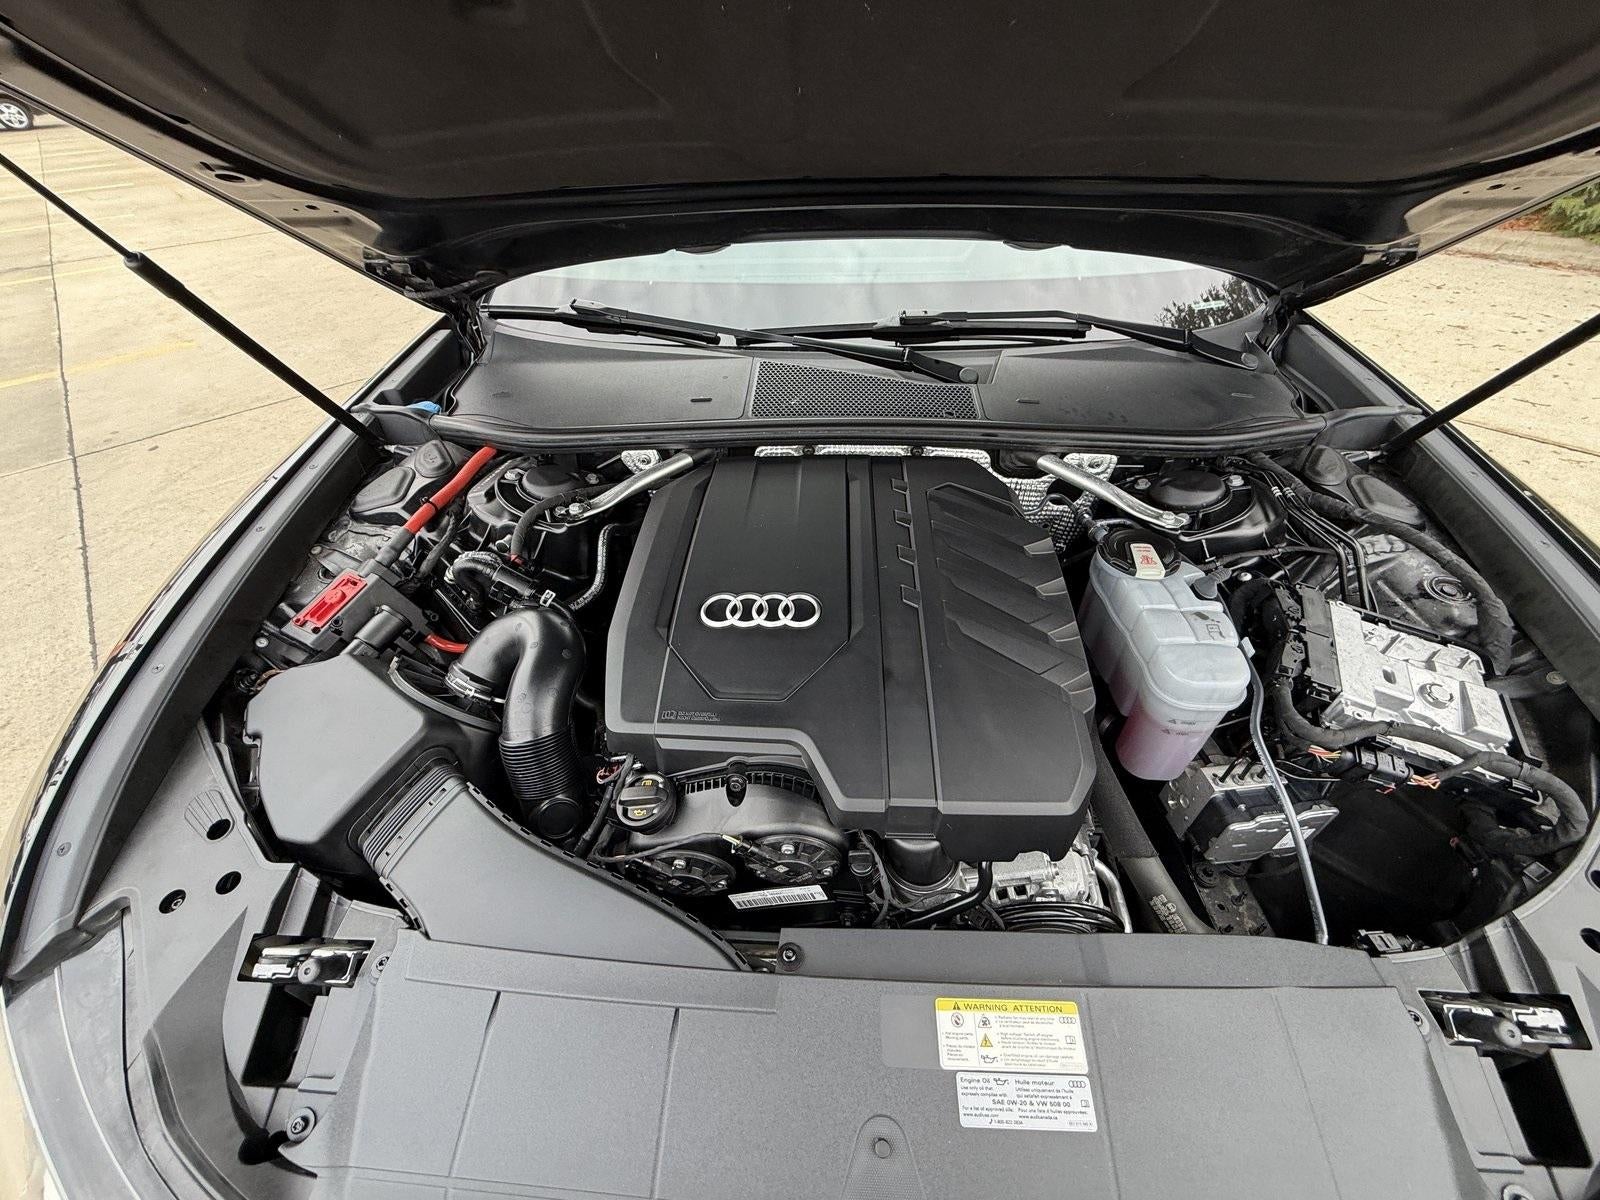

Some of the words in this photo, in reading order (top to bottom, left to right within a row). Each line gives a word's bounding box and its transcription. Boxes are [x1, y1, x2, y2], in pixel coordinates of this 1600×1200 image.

[963, 1003, 1008, 1012] WARNING
[1013, 1004, 1063, 1013] ATTENTION
[960, 1076, 980, 1085] Engine
[992, 1098, 1005, 1106] SAE
